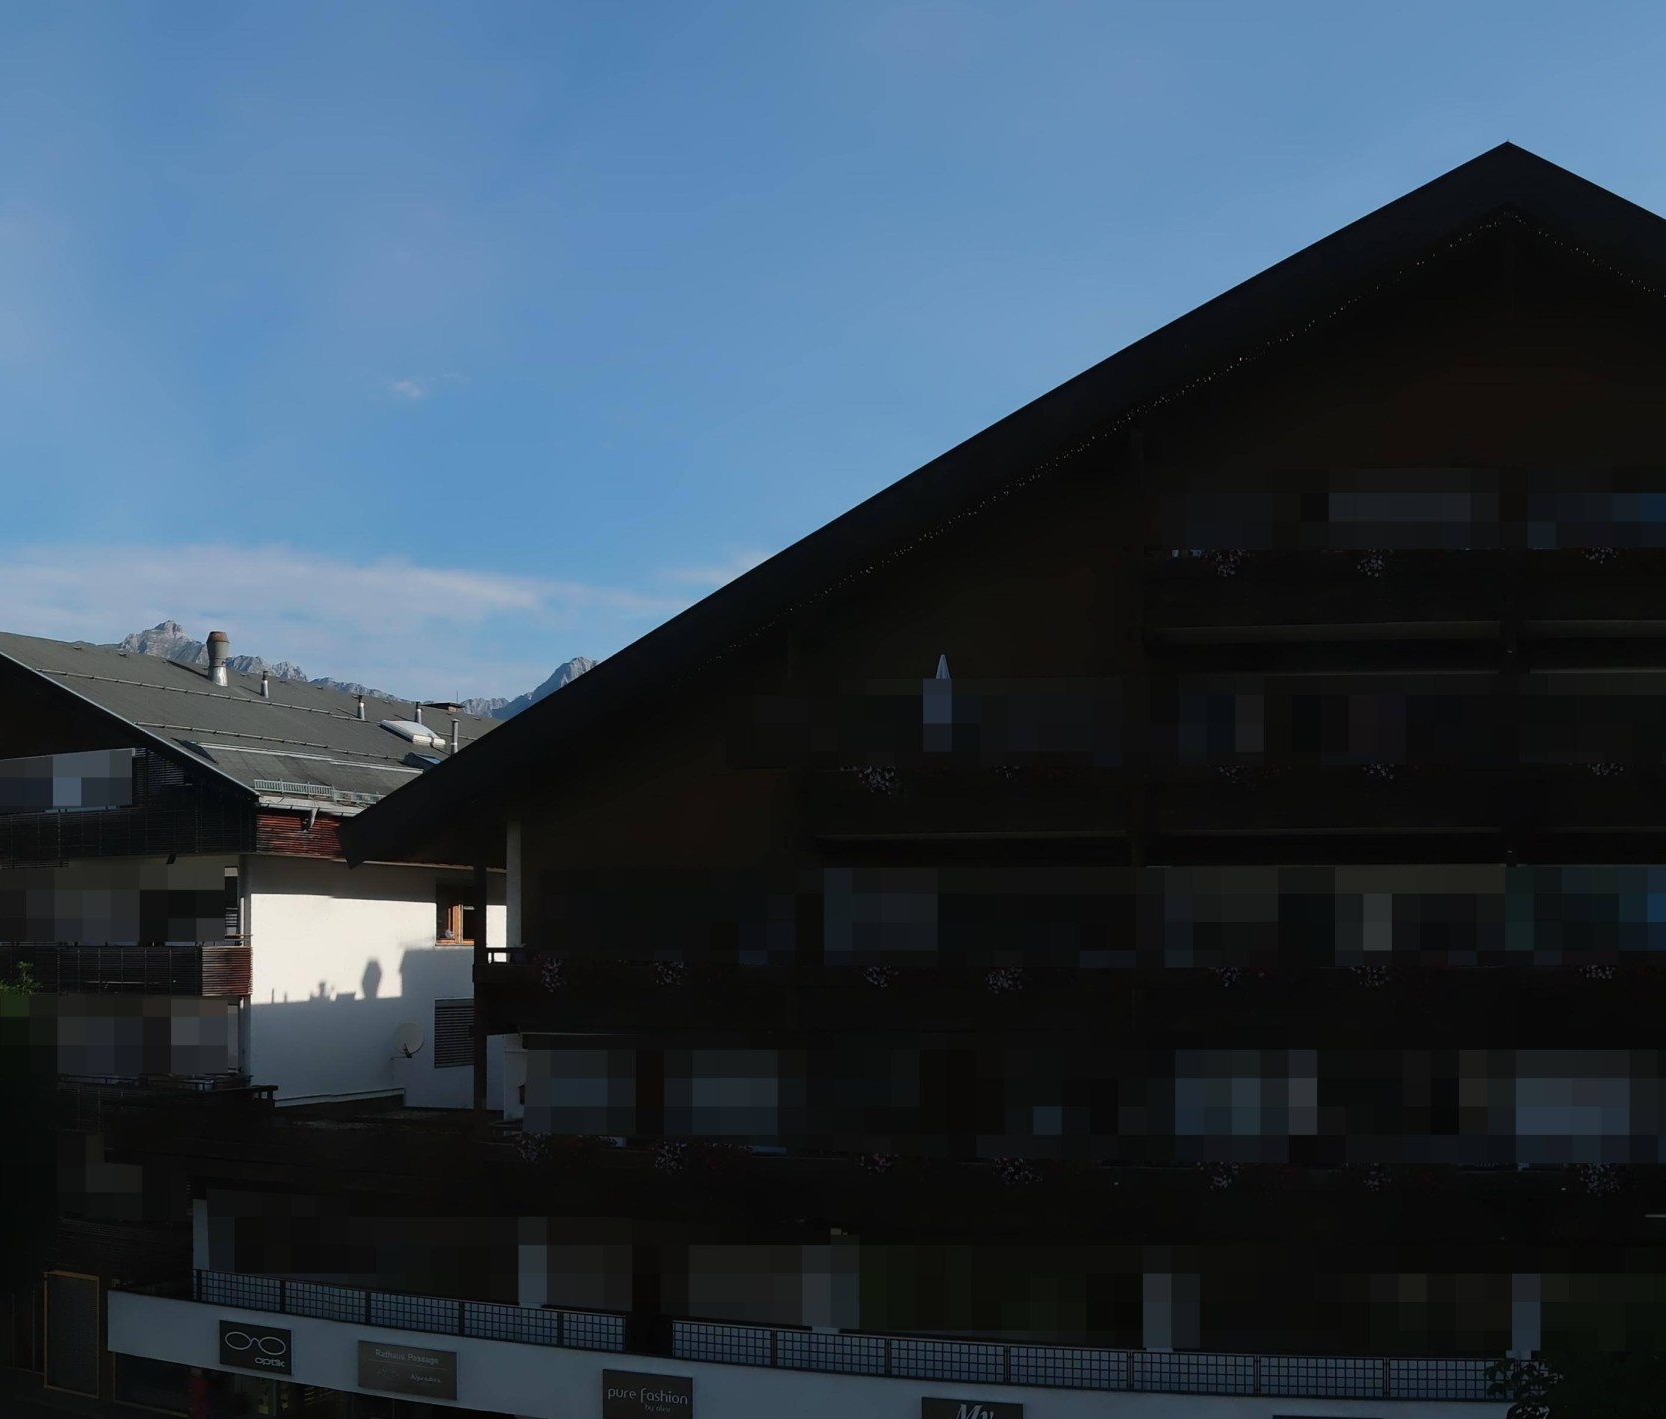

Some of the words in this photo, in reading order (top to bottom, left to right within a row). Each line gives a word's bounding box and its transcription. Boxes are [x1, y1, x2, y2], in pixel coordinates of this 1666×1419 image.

[254, 1357, 286, 1369] optik
[607, 1388, 637, 1401] pure
[640, 1387, 688, 1406] fashion
